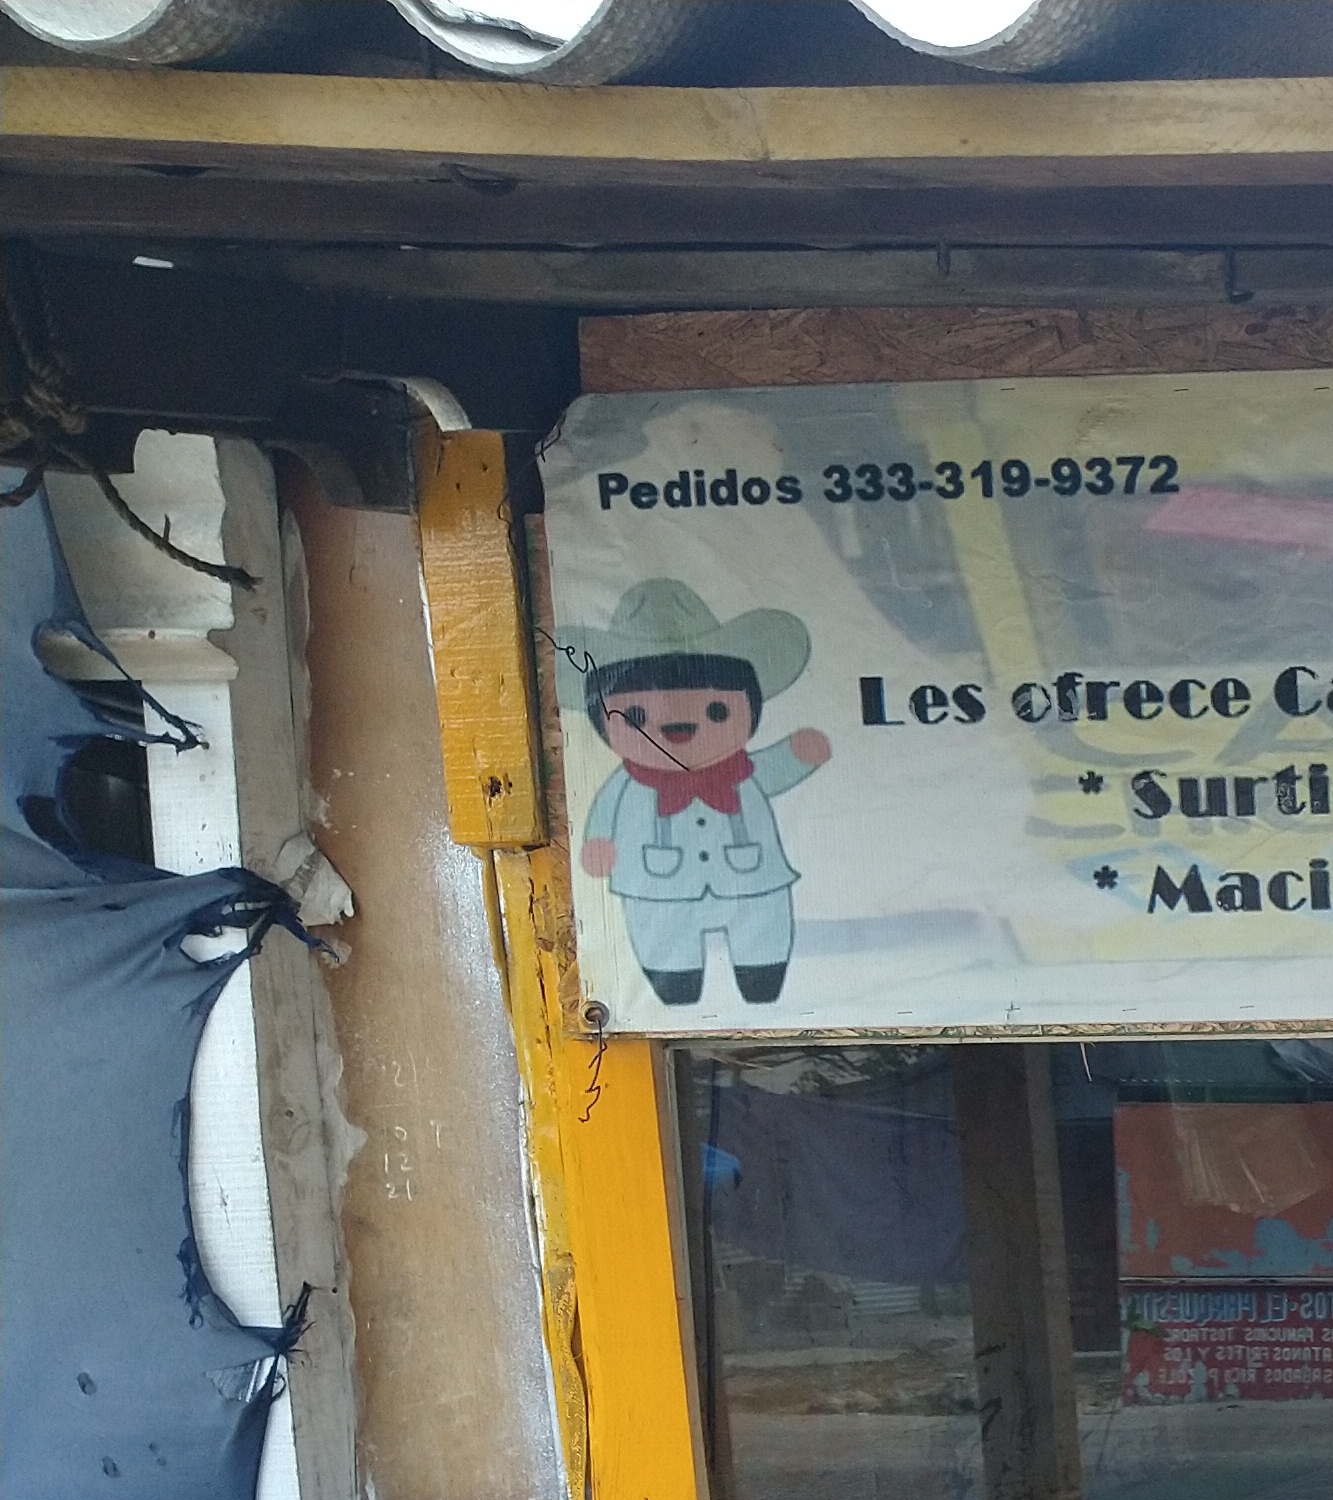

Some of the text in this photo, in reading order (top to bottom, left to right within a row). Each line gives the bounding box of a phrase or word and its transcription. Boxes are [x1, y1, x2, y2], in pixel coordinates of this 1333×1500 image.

[599, 456, 1180, 511] Pedidos 333-319-9372
[860, 675, 986, 725] Les
[1011, 674, 1252, 722] ofrece
